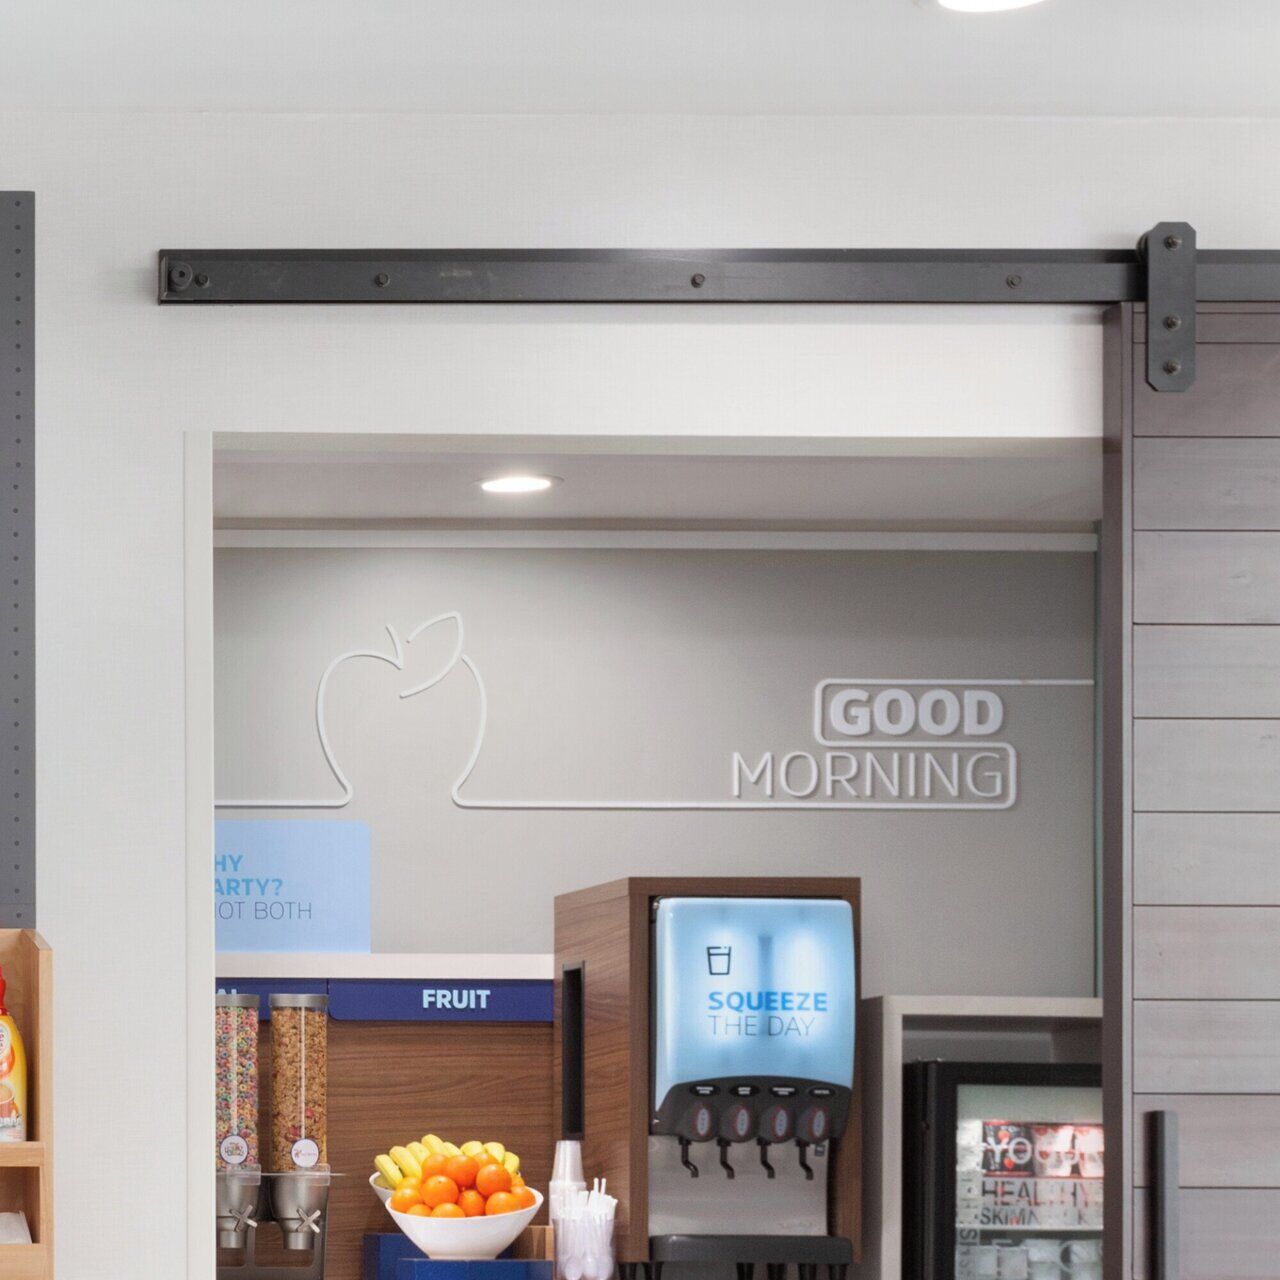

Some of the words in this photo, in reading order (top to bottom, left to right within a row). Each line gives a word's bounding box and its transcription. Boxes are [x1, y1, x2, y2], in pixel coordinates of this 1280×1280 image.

[830, 688, 1004, 736] GOOD
[731, 751, 1004, 798] MORNING
[215, 901, 245, 920] OT
[254, 901, 312, 920] BOTH
[422, 989, 491, 1009] FRUIT
[707, 991, 828, 1012] SQUEEZE
[708, 1015, 758, 1036] THE
[768, 1015, 816, 1036] DAY
